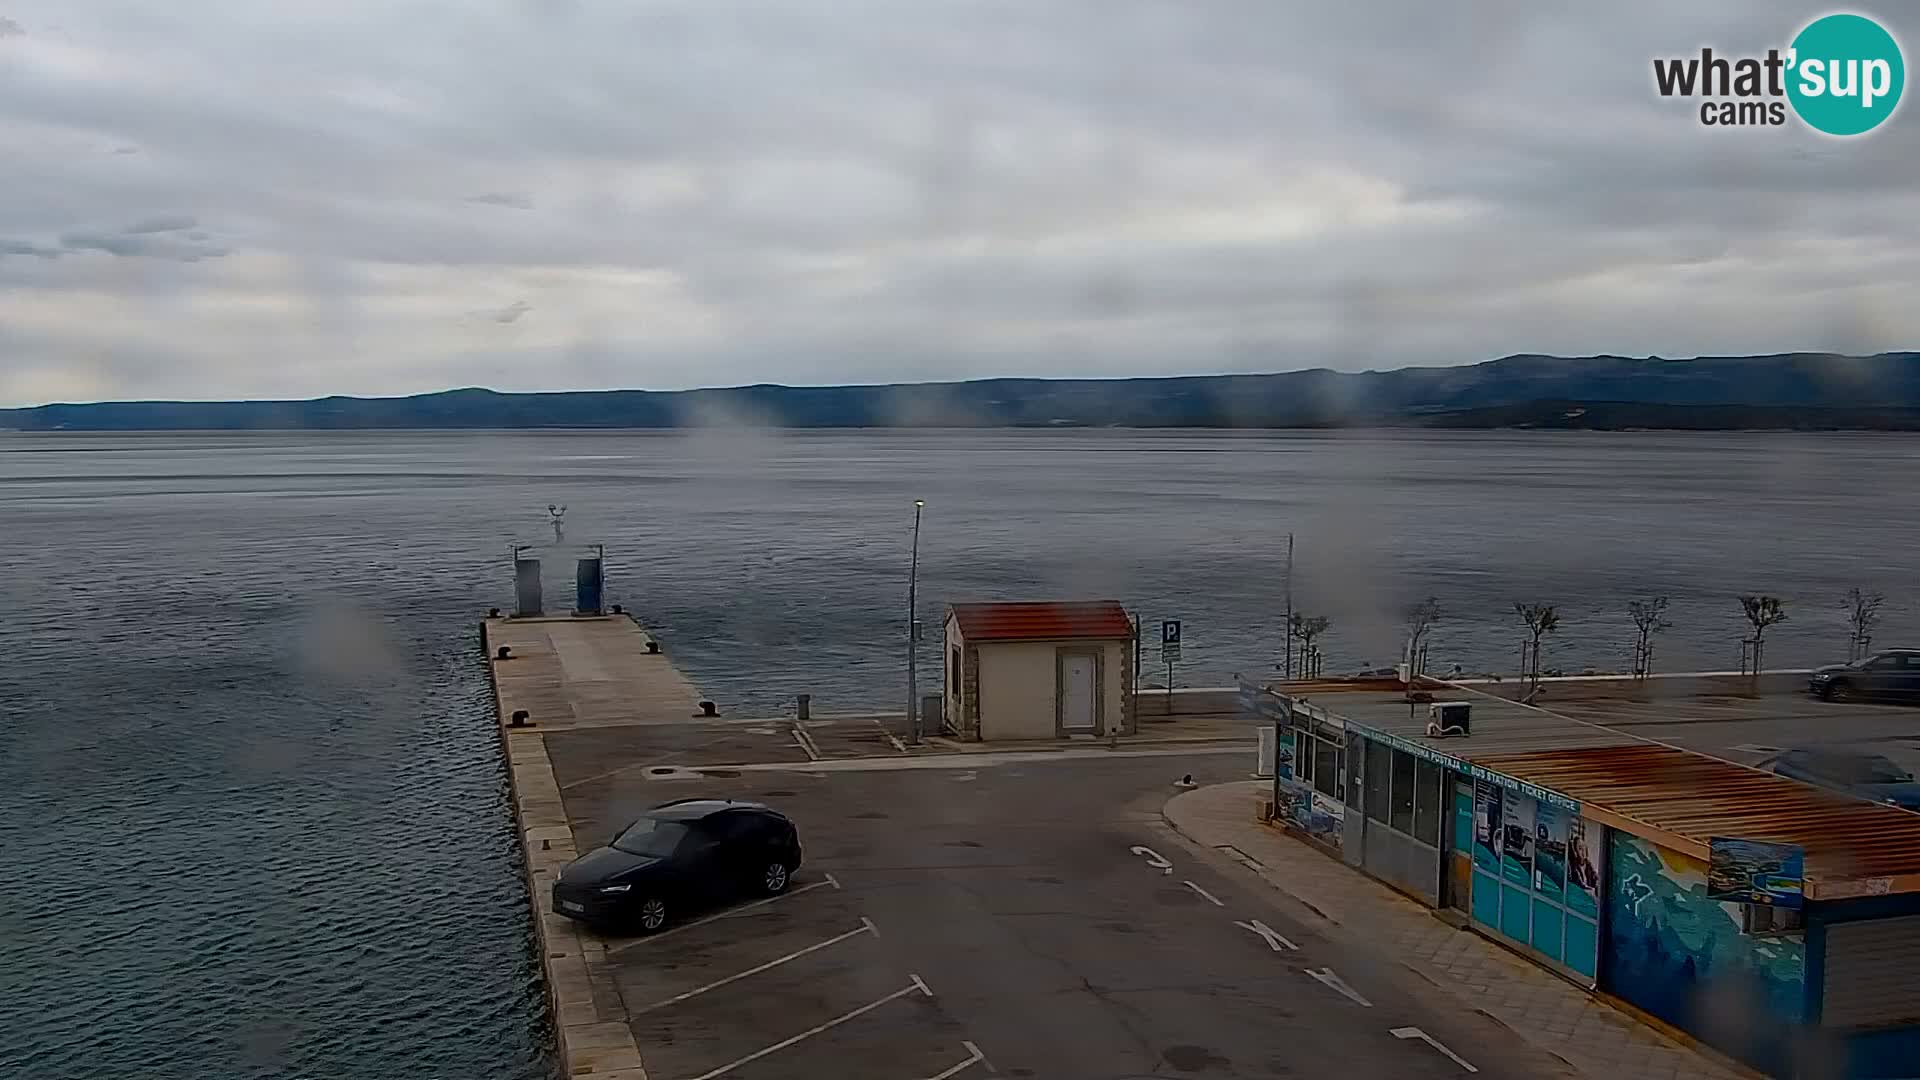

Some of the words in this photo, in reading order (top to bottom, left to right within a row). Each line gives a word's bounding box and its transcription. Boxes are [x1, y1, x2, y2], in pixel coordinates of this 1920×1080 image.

[1166, 622, 1177, 641] P
[1430, 752, 1461, 770] POSTAJA
[1471, 765, 1486, 779] BUS
[1486, 771, 1520, 791] STATION
[1521, 782, 1547, 801] TICKET
[1547, 793, 1577, 812] OFFICE
